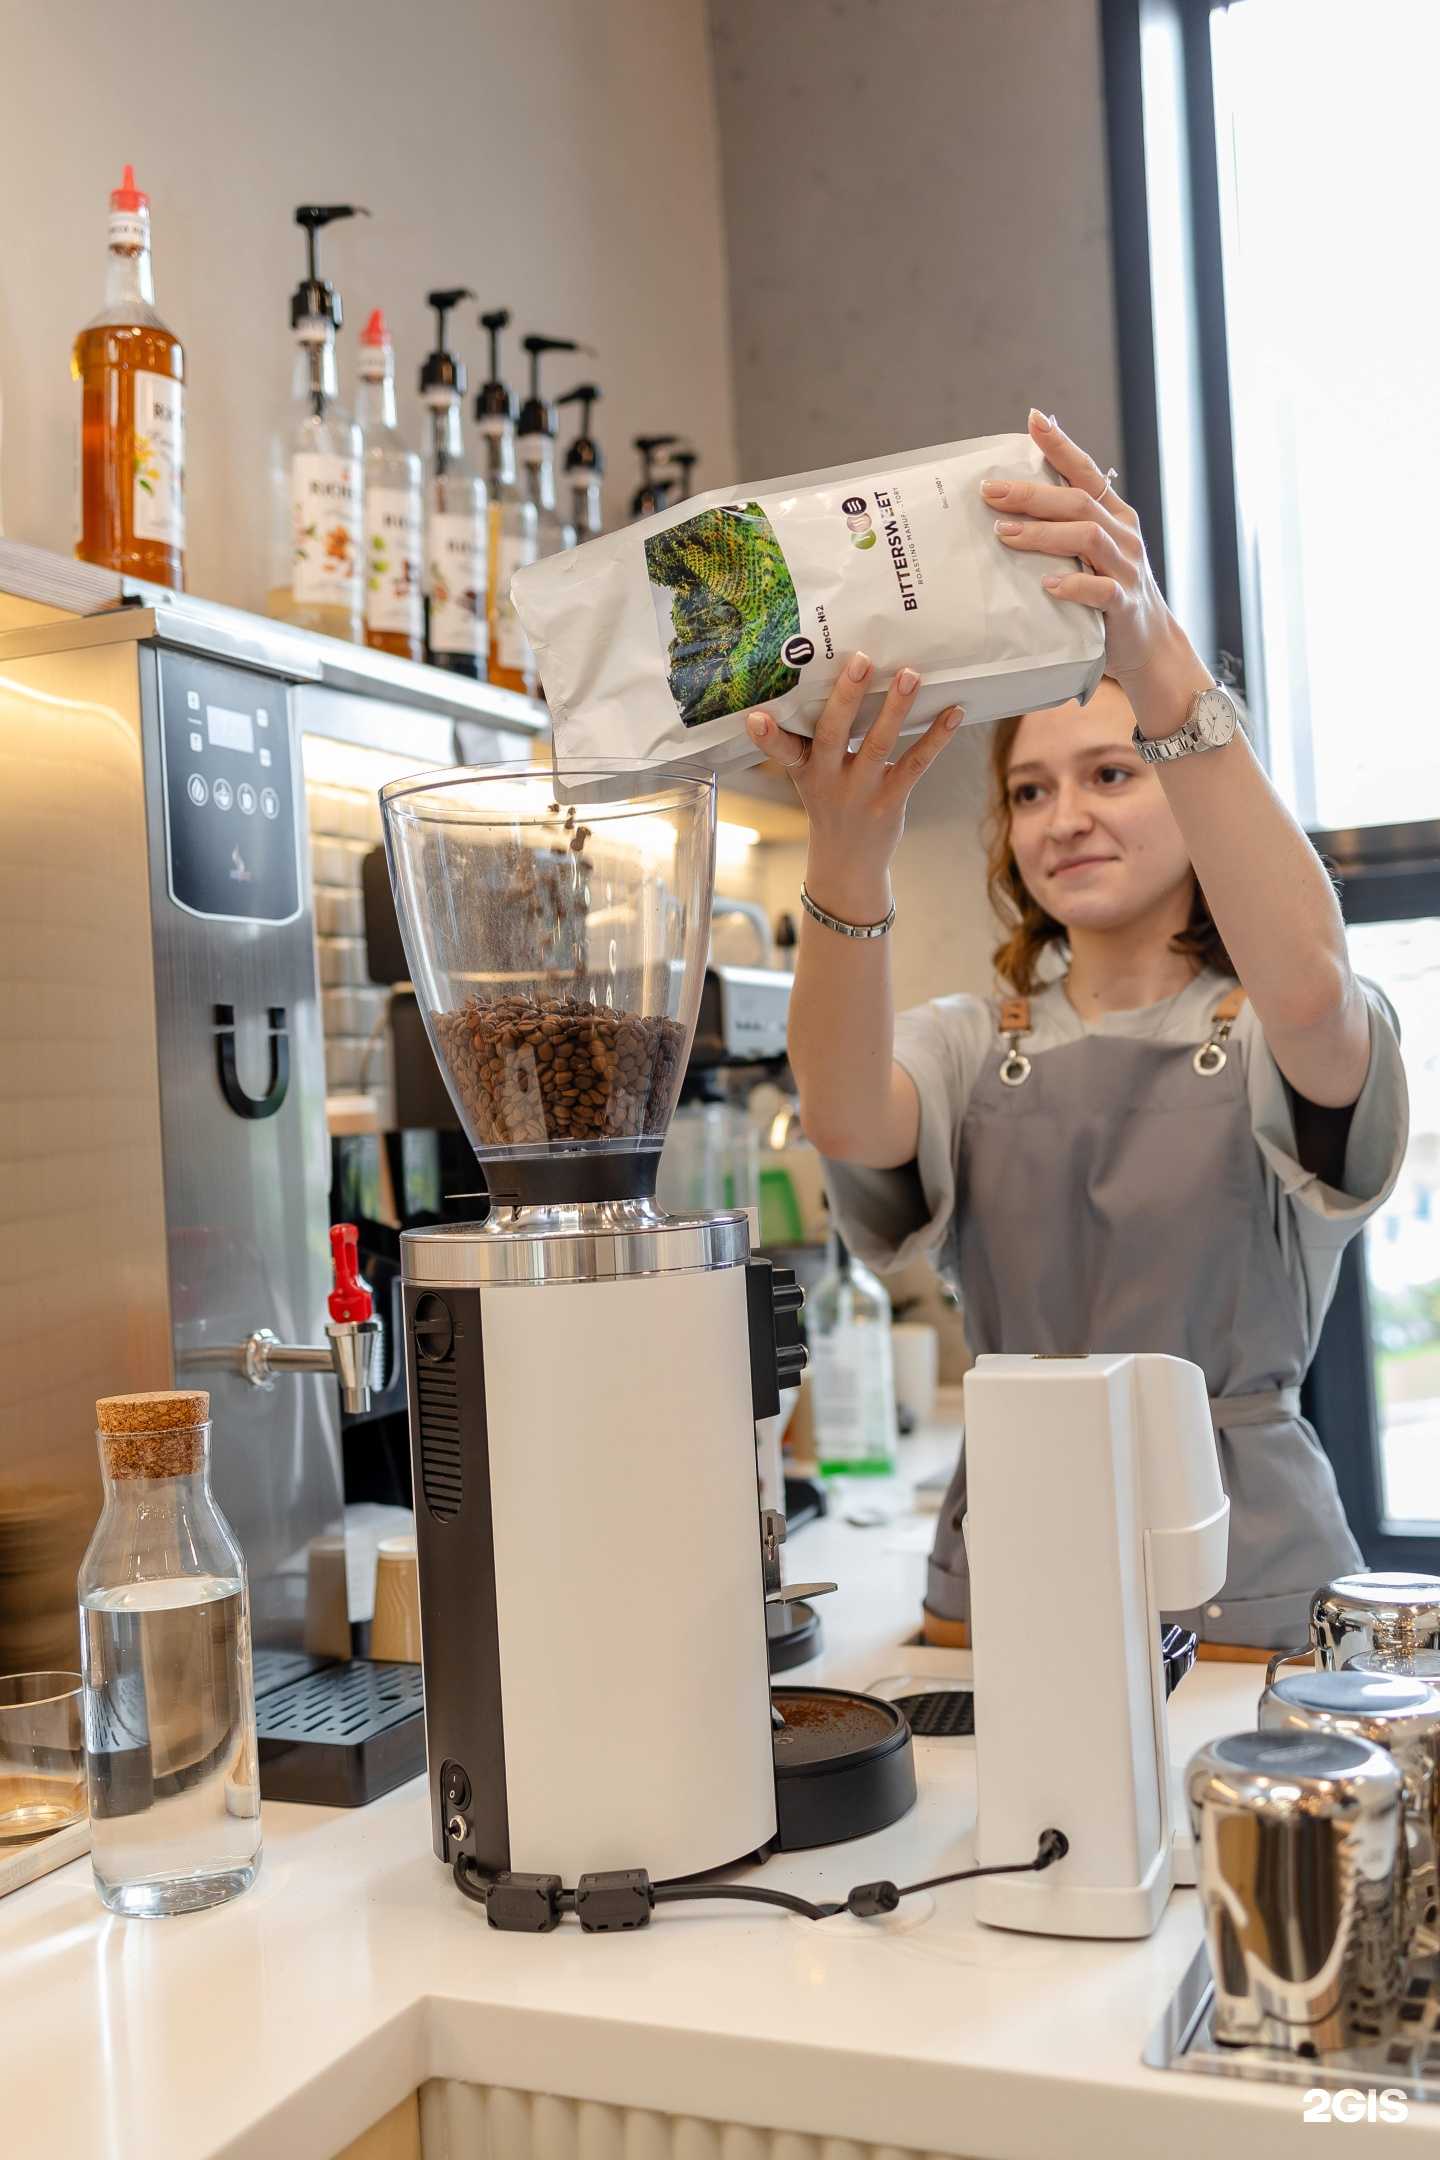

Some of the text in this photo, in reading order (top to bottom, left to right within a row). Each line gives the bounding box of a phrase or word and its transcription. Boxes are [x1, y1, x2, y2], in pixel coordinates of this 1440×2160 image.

[892, 487, 924, 585] ROASTING MANUFTORY
[822, 625, 834, 660] Смесь
